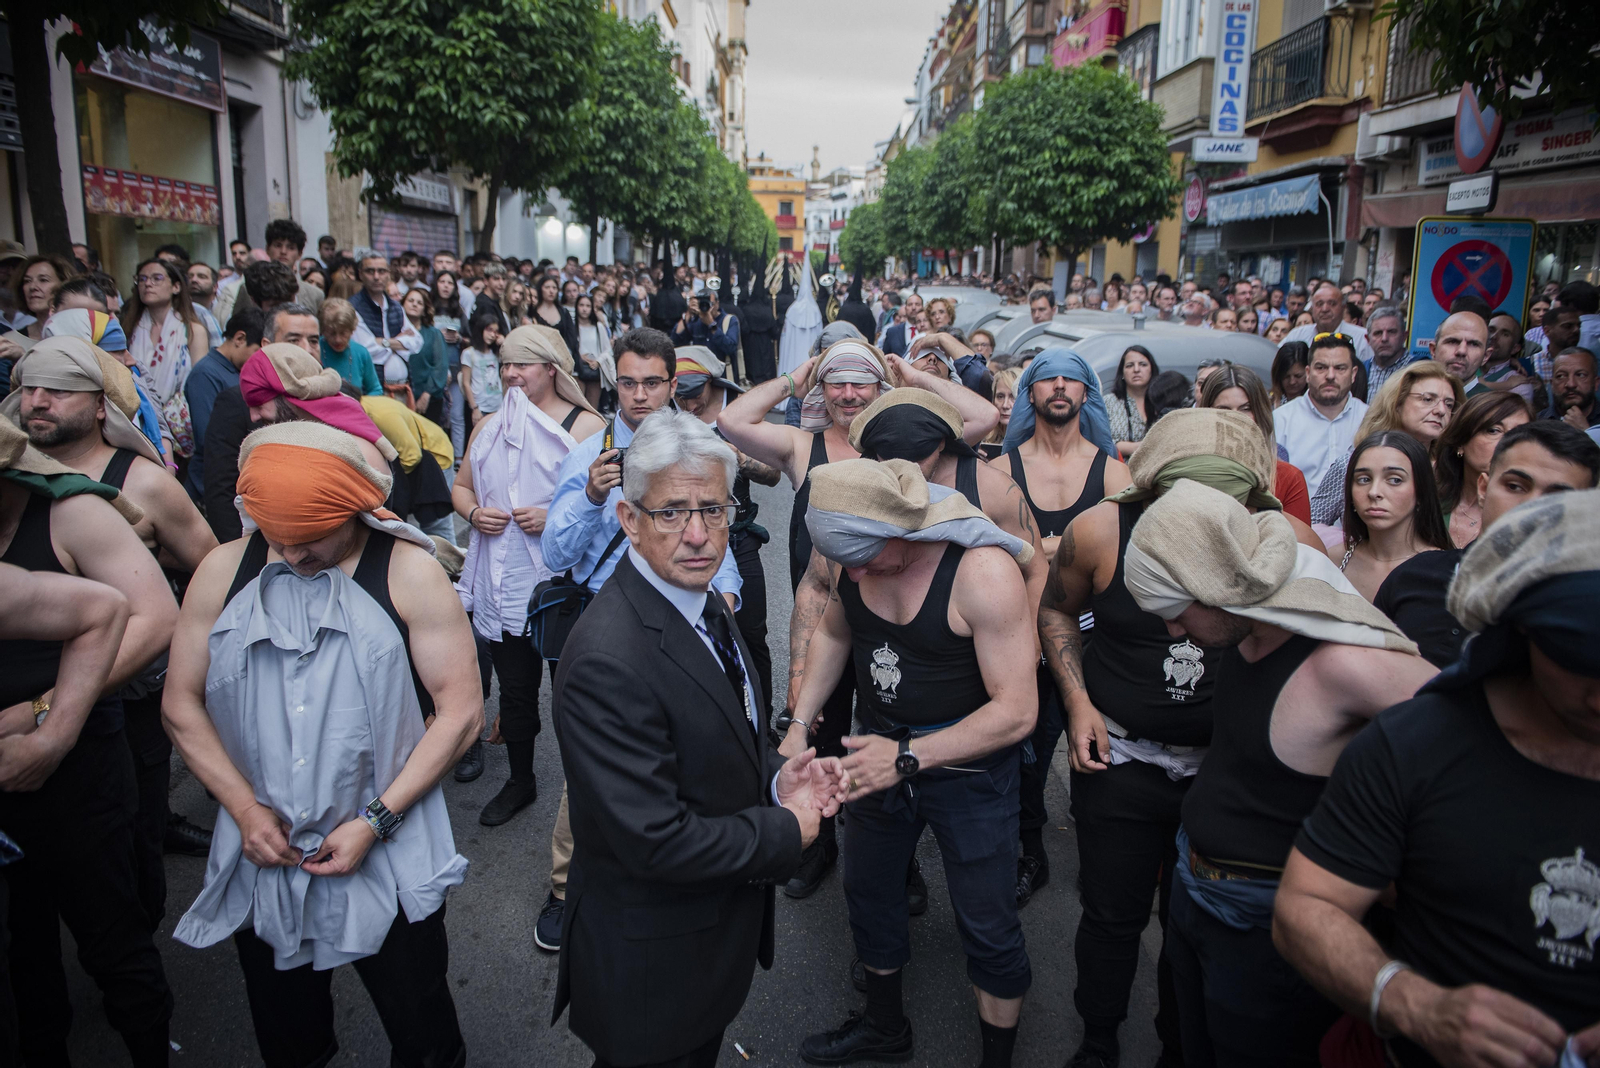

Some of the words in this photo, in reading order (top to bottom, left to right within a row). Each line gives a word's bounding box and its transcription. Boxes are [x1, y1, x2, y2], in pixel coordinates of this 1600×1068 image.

[1218, 13, 1247, 132] COCINAS
[1514, 118, 1553, 137] SIGMA
[1427, 138, 1456, 155] WERT
[1541, 130, 1594, 151] SINGER
[1497, 142, 1520, 159] AFF
[1425, 155, 1459, 171] BERNI
[1449, 189, 1471, 202] EXCEPTO
[1471, 186, 1490, 199] MOTOS
[1240, 193, 1252, 216] de
[1253, 190, 1266, 216] las
[1171, 693, 1185, 701] XXX
